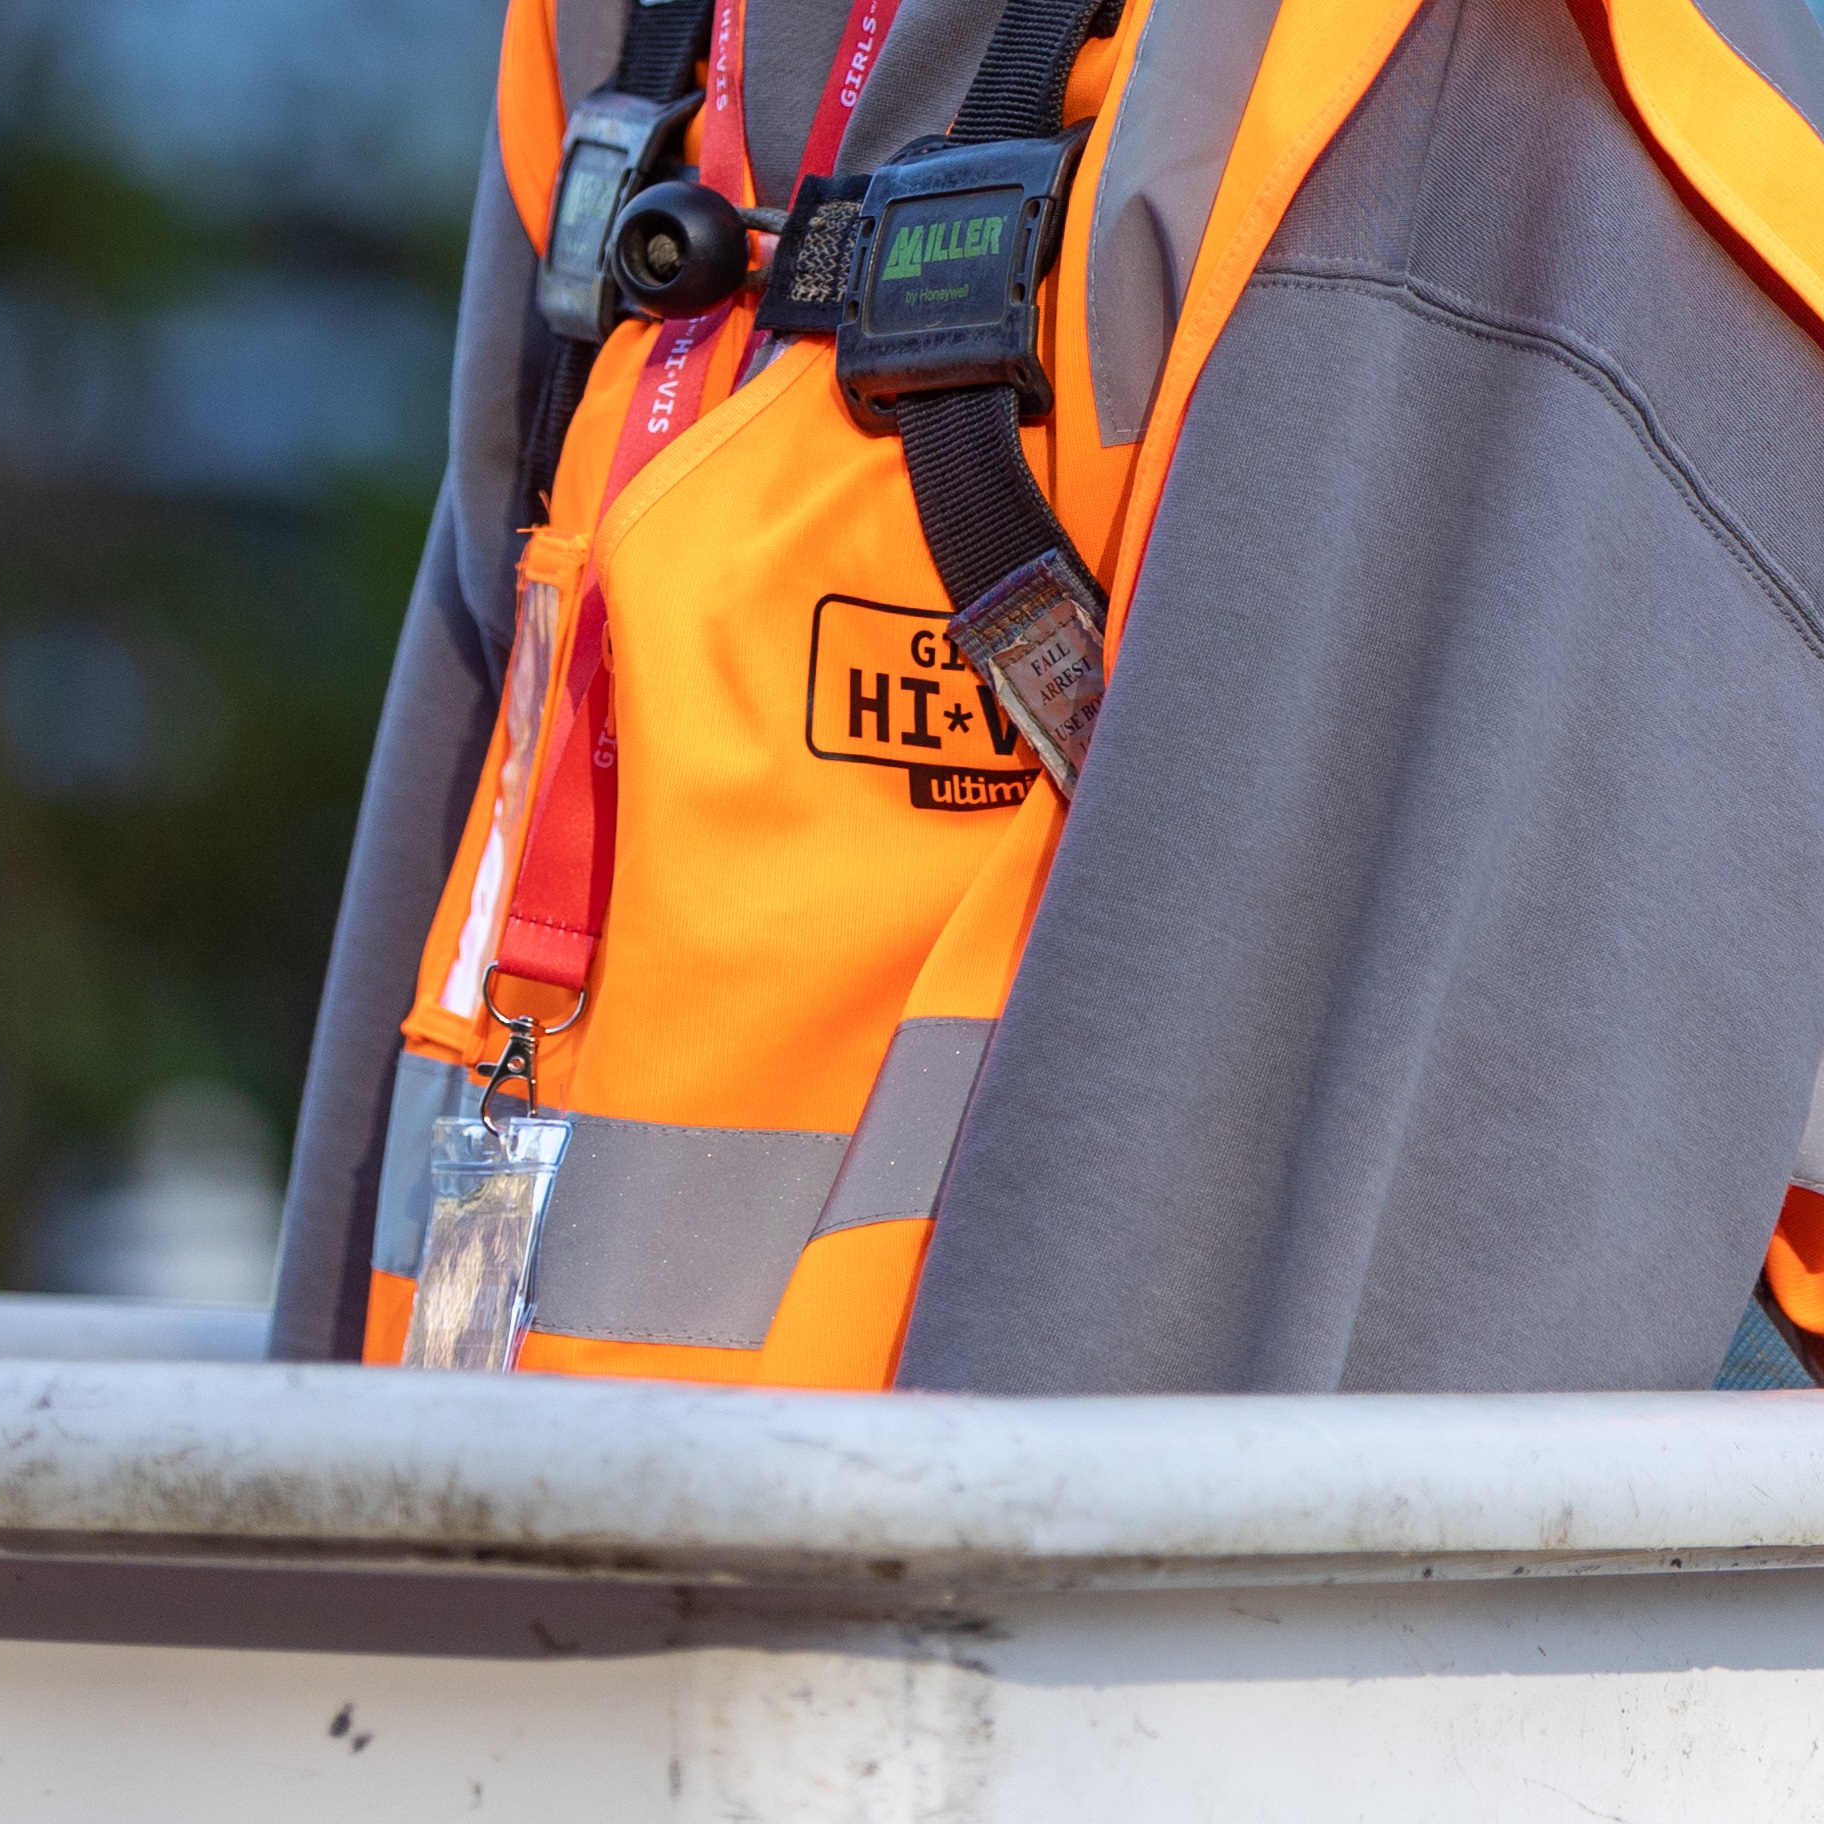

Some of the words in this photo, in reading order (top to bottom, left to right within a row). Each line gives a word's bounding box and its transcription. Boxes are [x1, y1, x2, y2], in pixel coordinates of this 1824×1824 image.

[881, 216, 1004, 281] MILLER
[906, 291, 918, 305] by
[920, 283, 970, 304] Honeywell
[1030, 642, 1071, 677] FALL
[1039, 655, 1094, 706] ARREST
[1055, 713, 1084, 742] USE
